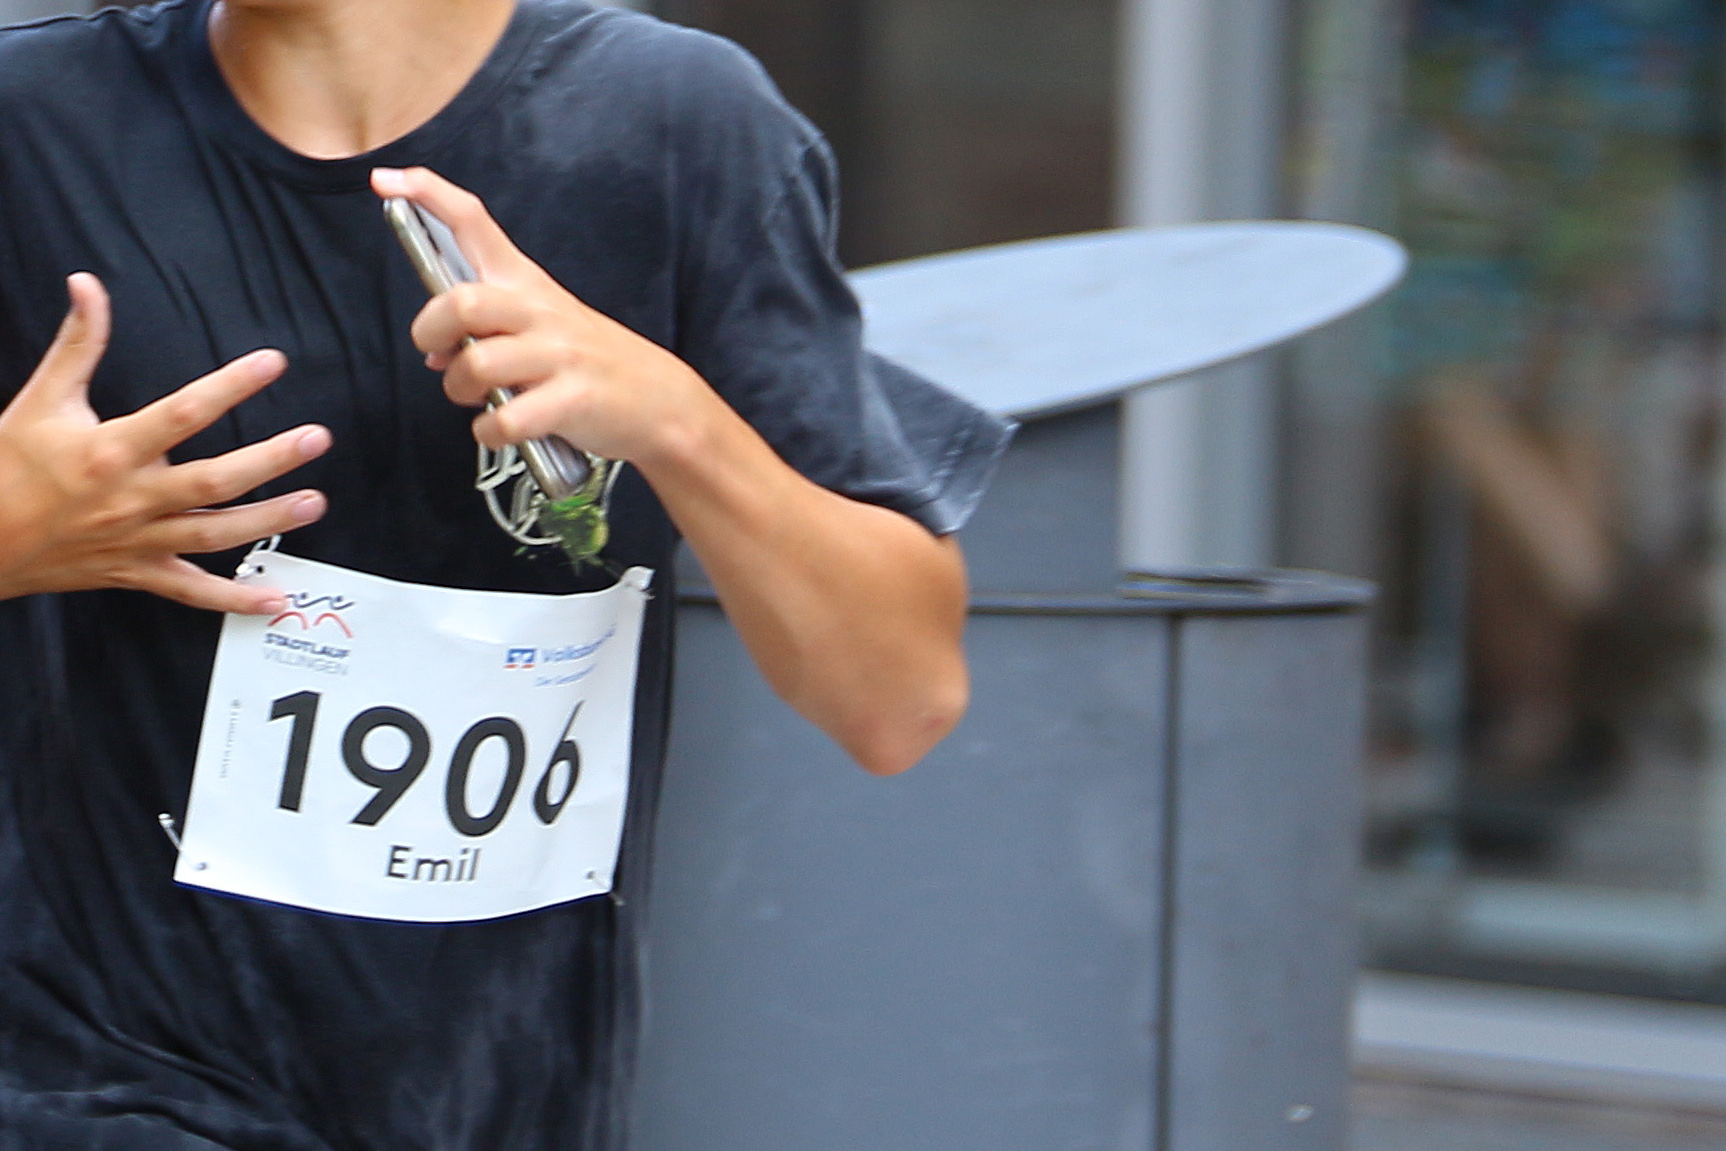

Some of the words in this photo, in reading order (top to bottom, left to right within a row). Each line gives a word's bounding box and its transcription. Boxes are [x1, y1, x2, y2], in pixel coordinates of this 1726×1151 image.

[541, 632, 605, 662] Volksb
[268, 690, 584, 837] 1906
[386, 845, 481, 883] Emil
